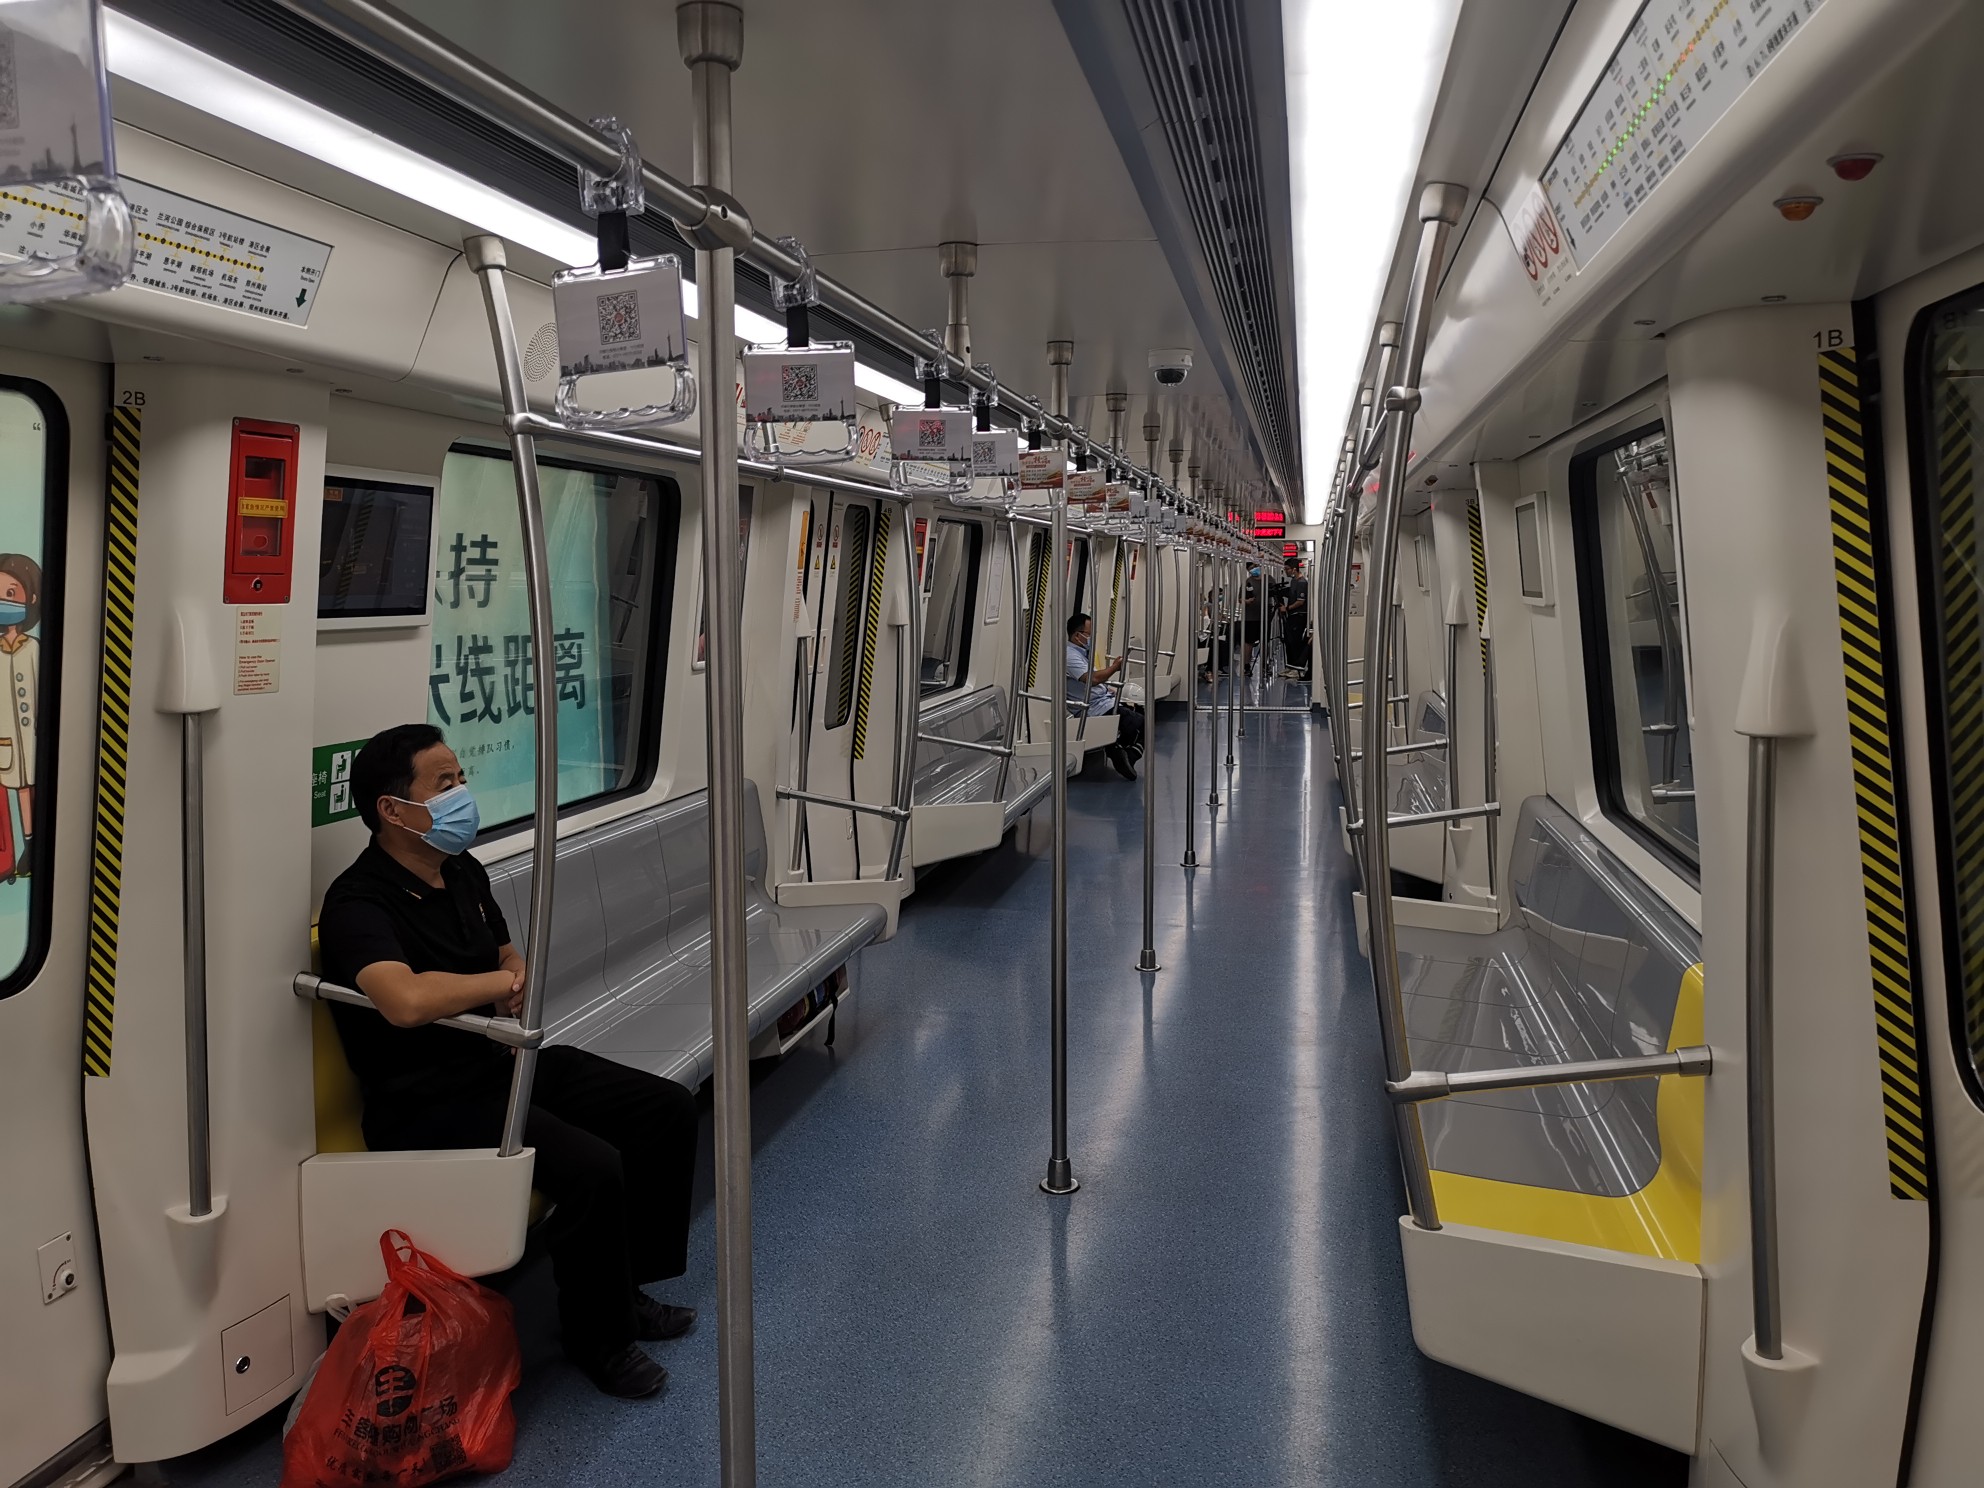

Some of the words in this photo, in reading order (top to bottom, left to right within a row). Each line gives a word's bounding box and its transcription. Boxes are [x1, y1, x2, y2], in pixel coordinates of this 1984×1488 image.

[1812, 329, 1844, 349] 1B
[122, 390, 146, 406] 2B
[435, 533, 499, 609] 持
[313, 789, 327, 799] Seat
